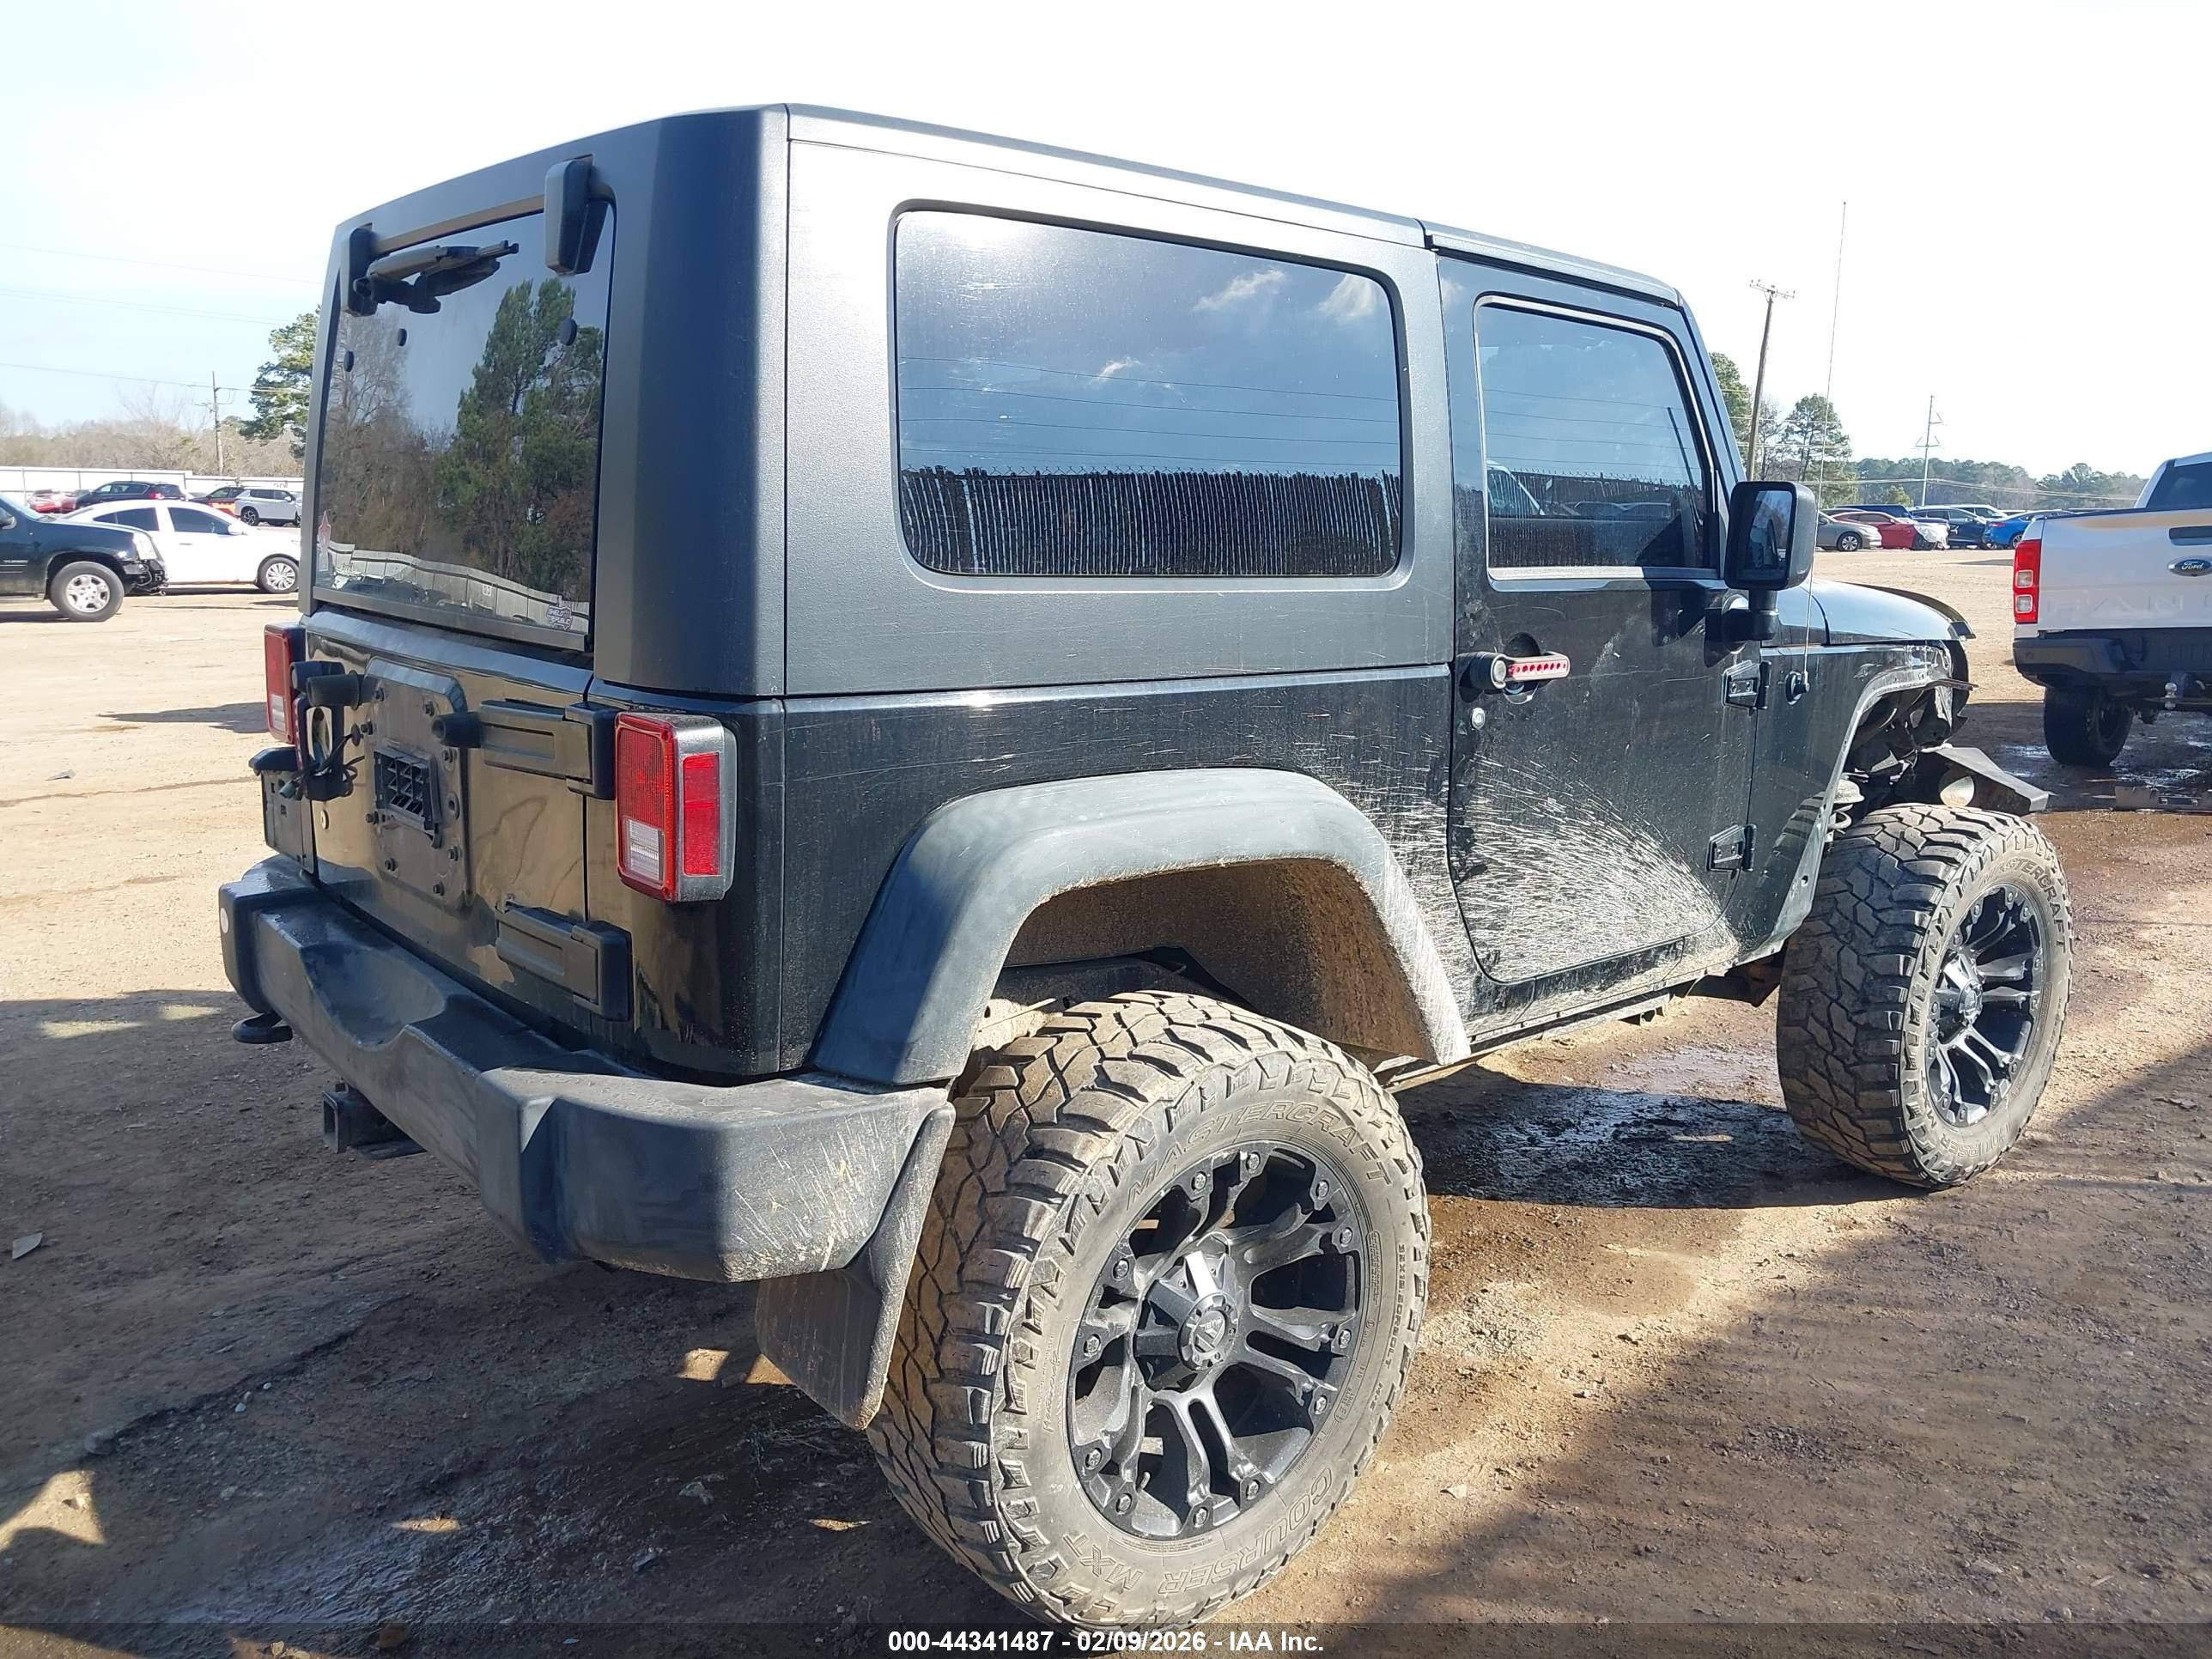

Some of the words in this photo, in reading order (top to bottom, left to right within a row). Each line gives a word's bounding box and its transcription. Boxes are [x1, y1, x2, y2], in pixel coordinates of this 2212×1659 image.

[2181, 561, 2204, 570] Ford
[1126, 1100, 1392, 1211] MASTERCRAFT
[1063, 1533, 1142, 1591] MXT
[1158, 1468, 1333, 1595] COURSER
